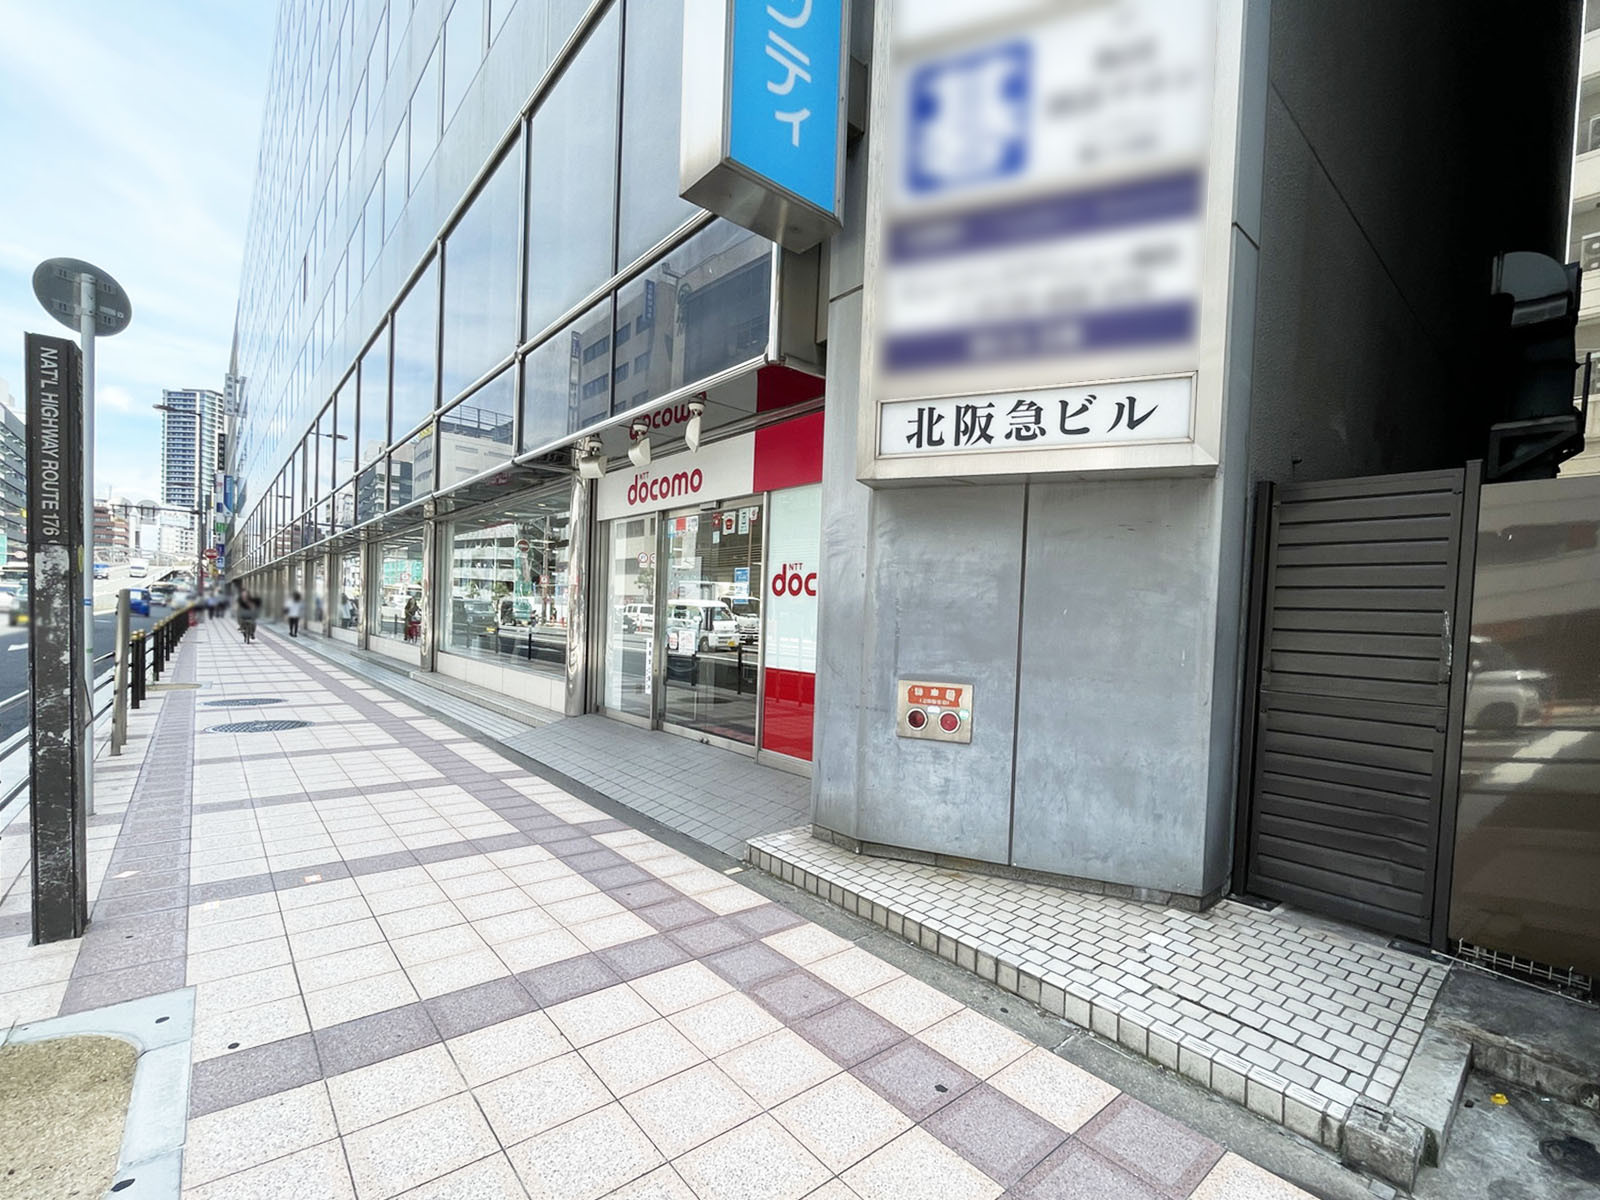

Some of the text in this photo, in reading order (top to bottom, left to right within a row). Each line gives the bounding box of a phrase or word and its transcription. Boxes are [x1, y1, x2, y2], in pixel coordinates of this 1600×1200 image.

[40, 346, 58, 388] NAT'L
[41, 392, 59, 458] HIGHWAY
[906, 394, 1159, 449] 北阪急ビル
[41, 459, 59, 510] ROUTE
[628, 468, 703, 505] docomo
[42, 513, 60, 536] 176
[772, 563, 817, 597] doc
[789, 562, 804, 571] NTT
